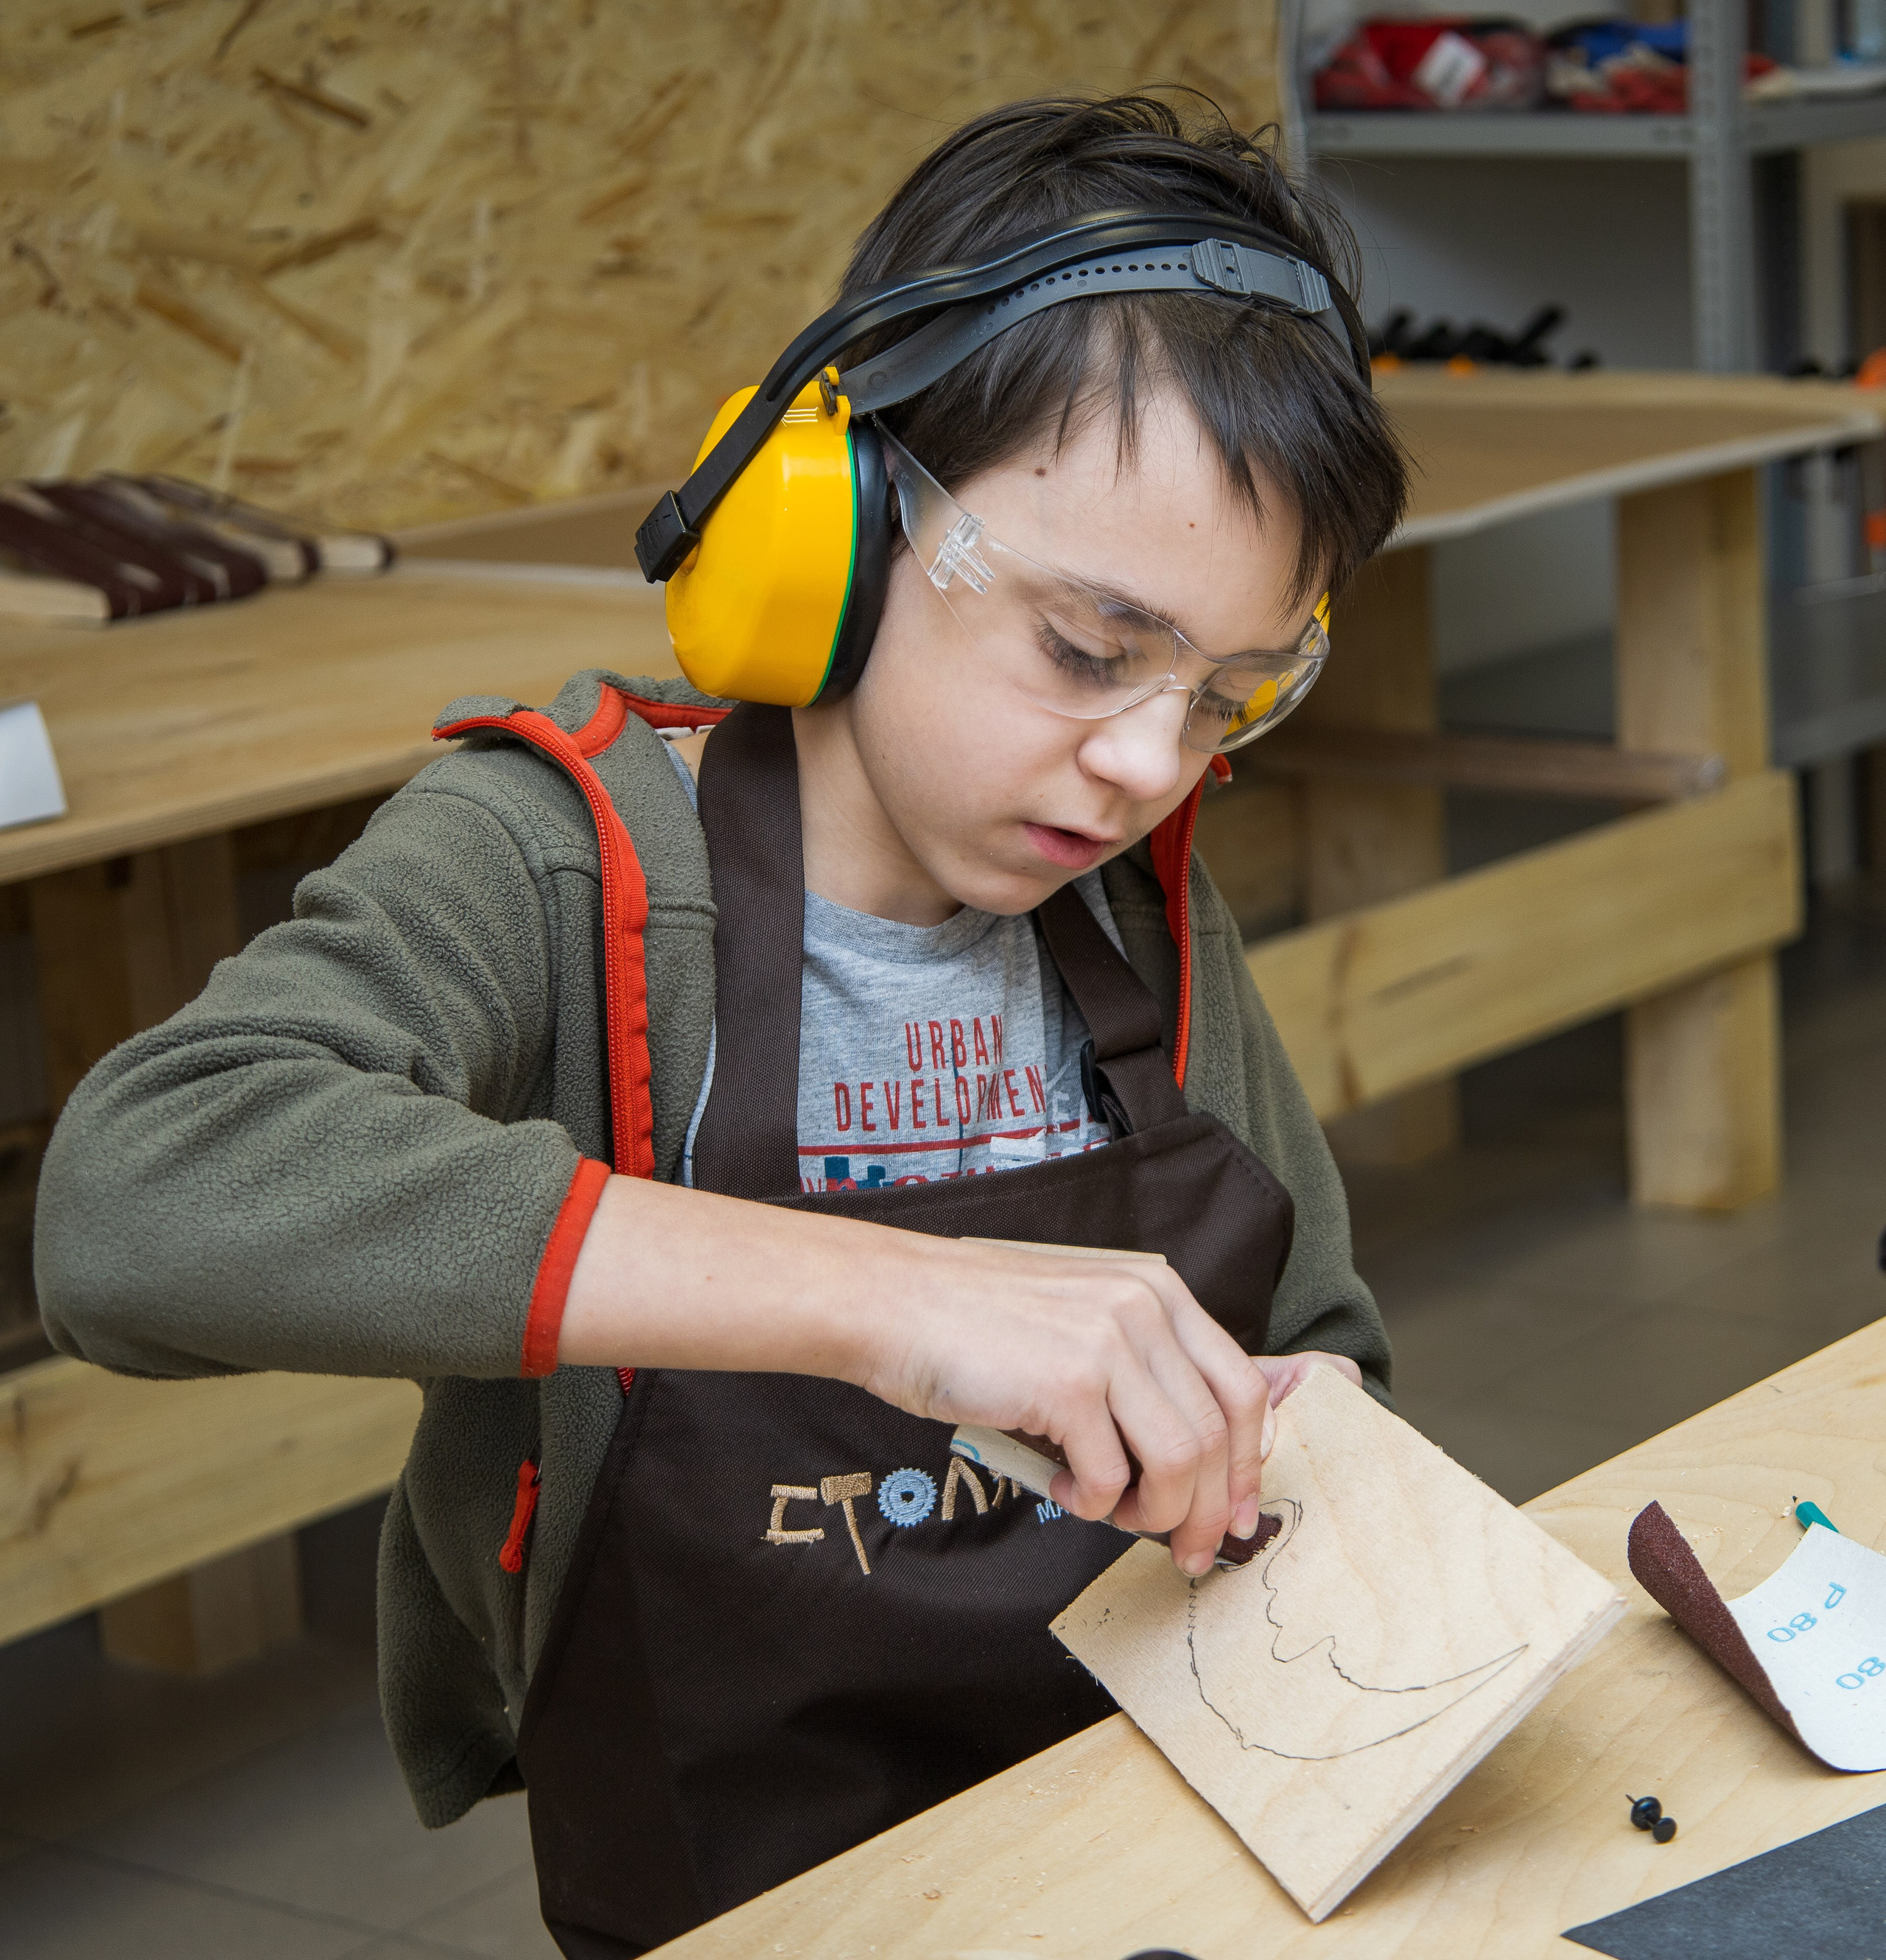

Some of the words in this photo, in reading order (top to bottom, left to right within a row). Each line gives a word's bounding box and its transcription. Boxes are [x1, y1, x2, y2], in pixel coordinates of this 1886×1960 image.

[905, 1015, 1003, 1071] URBAN
[834, 1064, 1047, 1132] DEVELOPMEN
[1824, 1581, 1847, 1609] P
[1767, 1611, 1818, 1642] 80
[1835, 1656, 1886, 1690] 80
